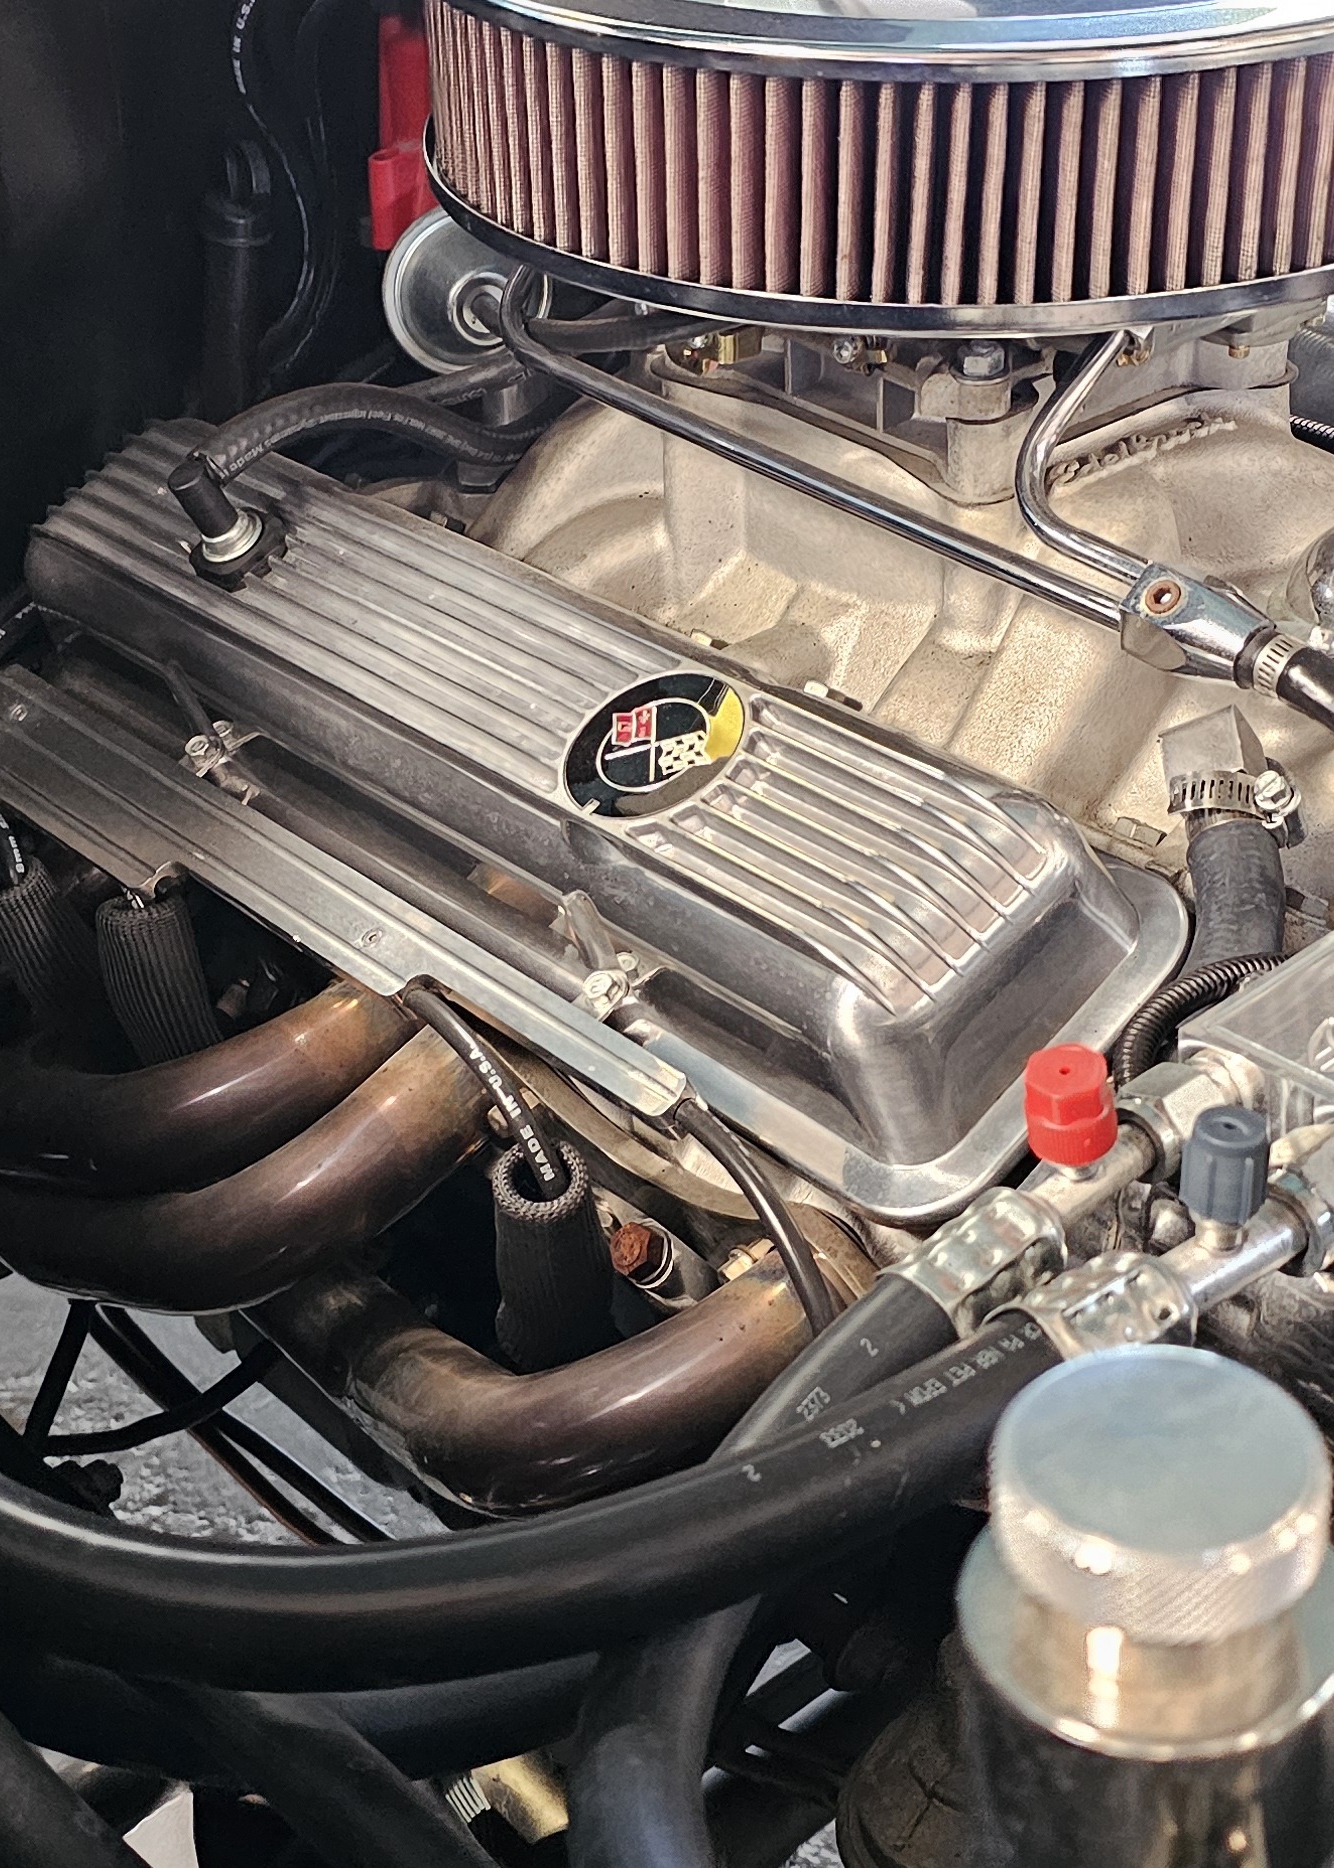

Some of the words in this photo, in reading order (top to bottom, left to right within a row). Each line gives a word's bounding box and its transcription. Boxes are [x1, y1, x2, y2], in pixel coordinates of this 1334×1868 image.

[236, 0, 256, 30] U.S.
[502, 1095, 522, 1119] IN
[520, 1123, 556, 1183] MADE
[860, 1337, 879, 1358] 2
[741, 1464, 762, 1483] 2
